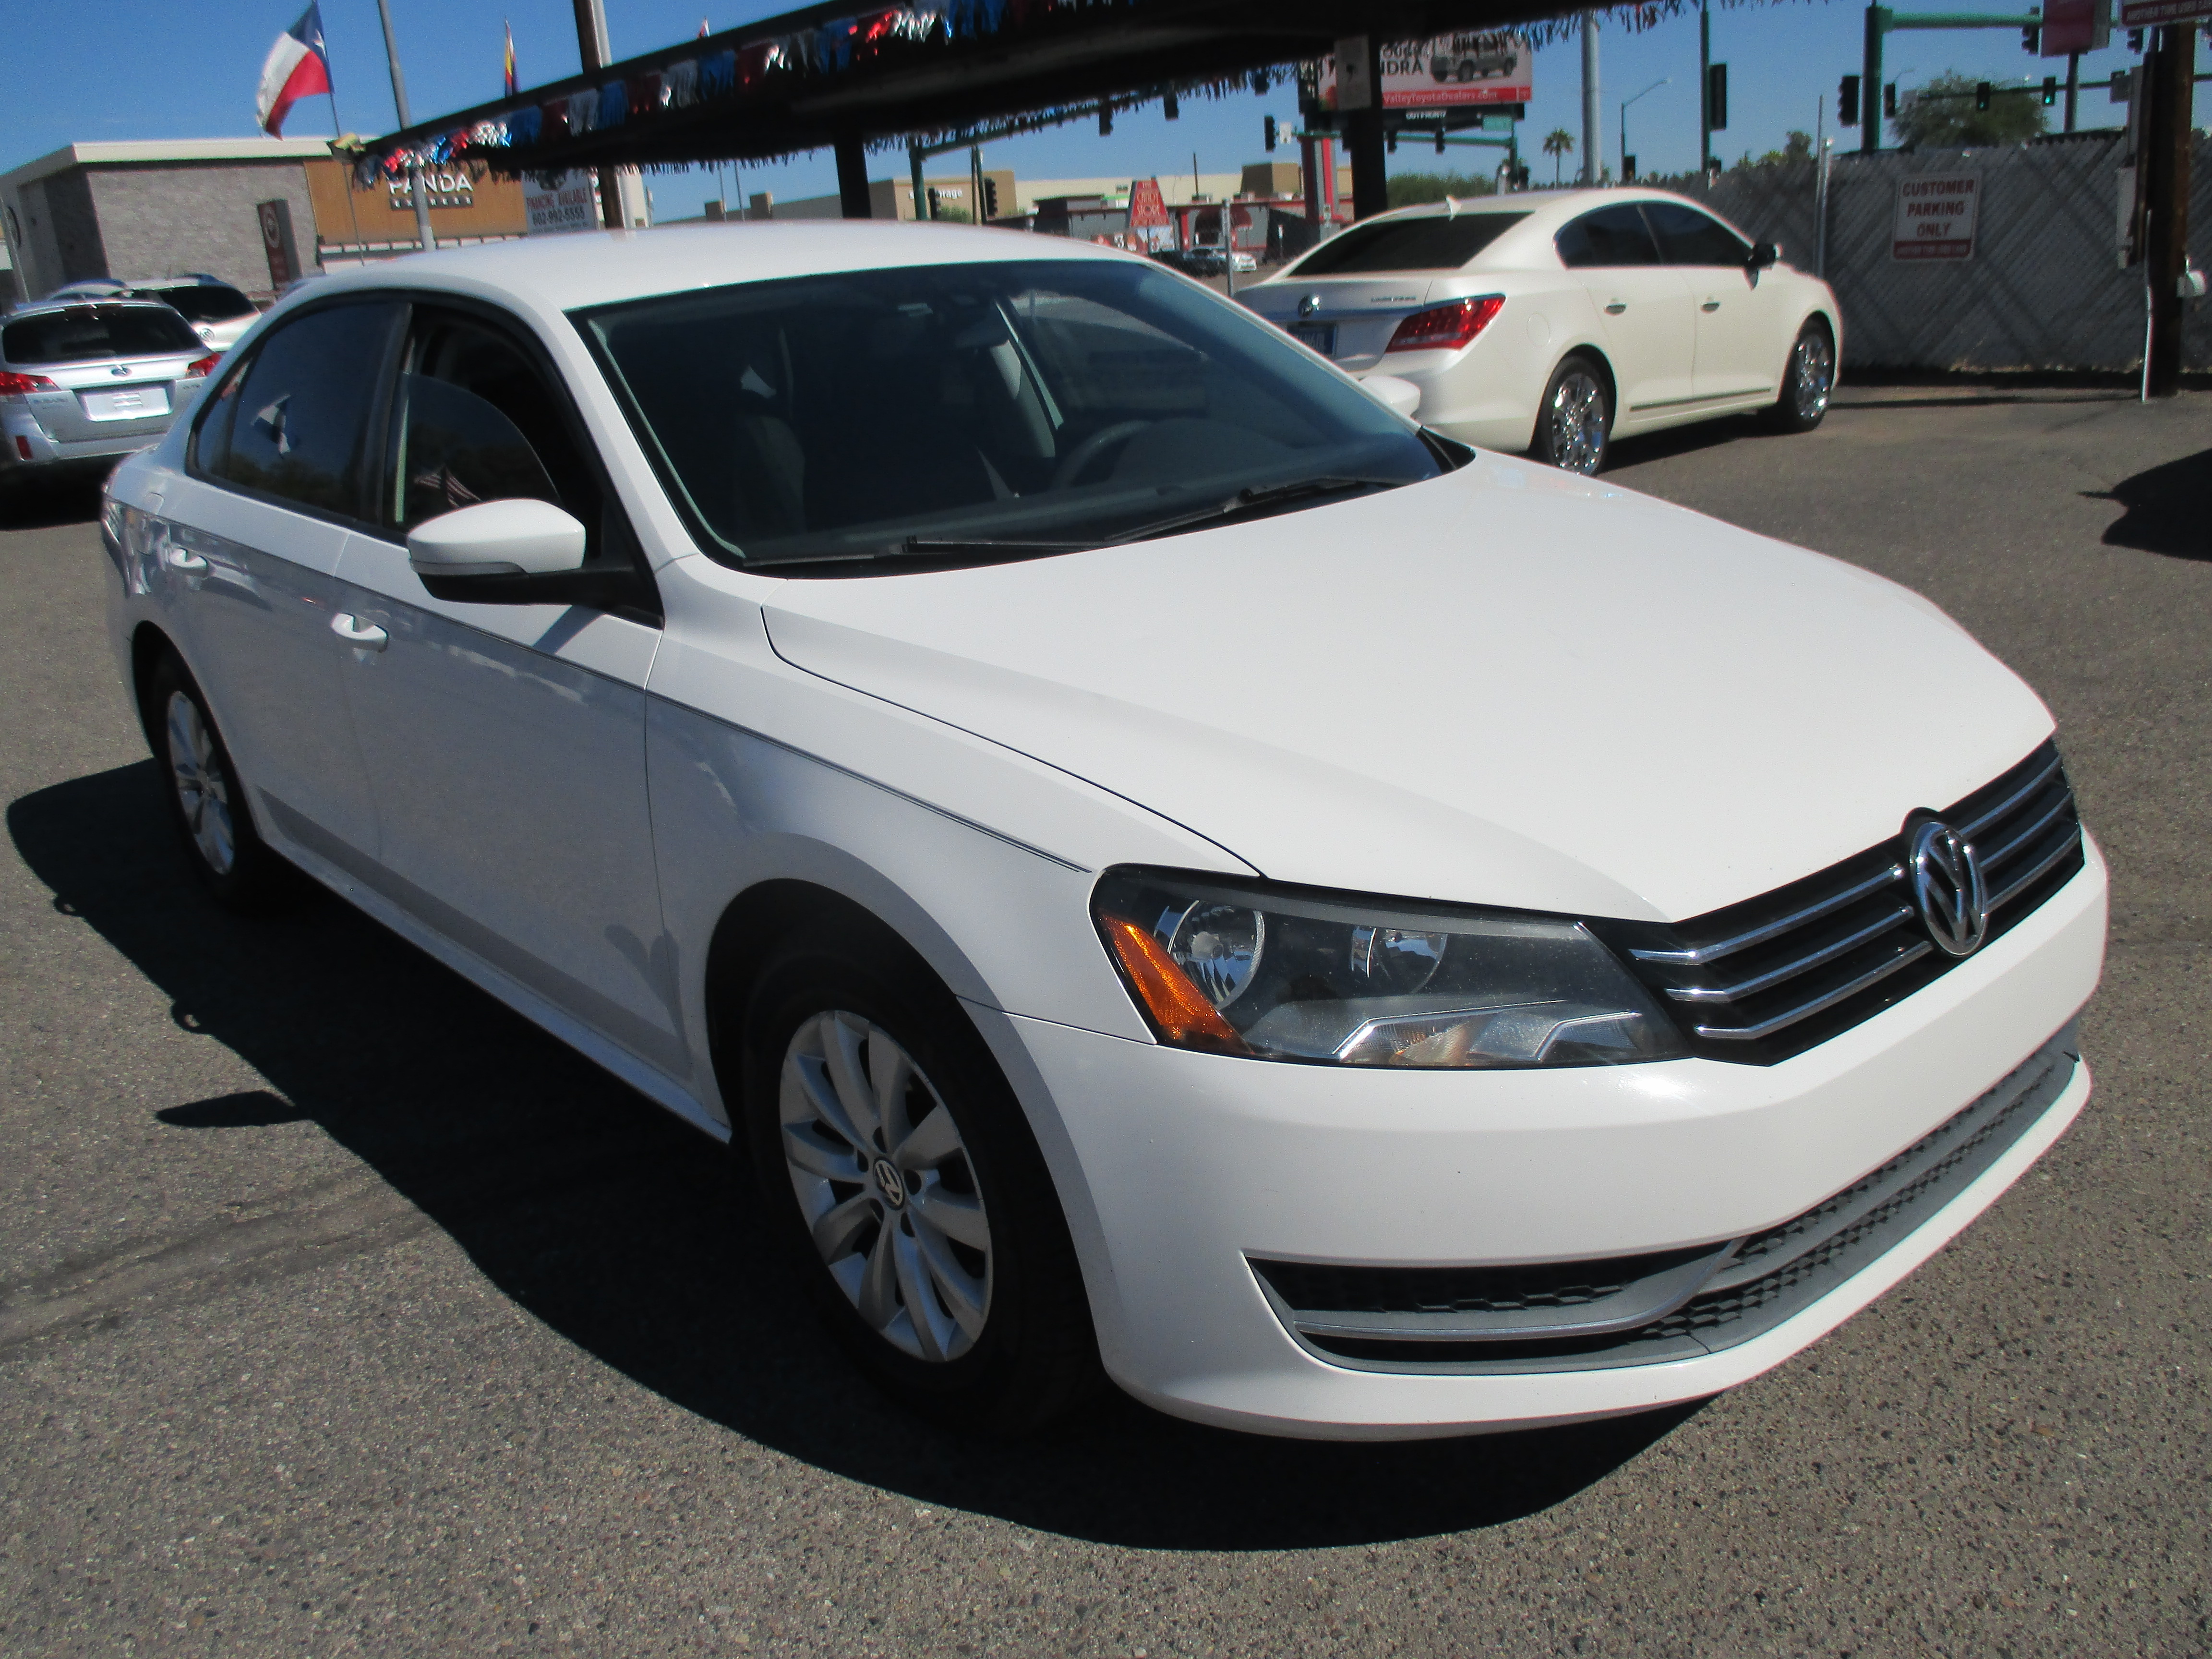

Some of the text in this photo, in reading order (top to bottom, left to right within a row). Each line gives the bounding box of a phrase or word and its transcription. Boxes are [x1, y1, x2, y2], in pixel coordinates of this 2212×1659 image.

[1902, 179, 1974, 197] CUSTOMER
[393, 196, 472, 208] EXRESS
[1907, 200, 1965, 217] PARKING
[1916, 222, 1951, 237] ONLY
